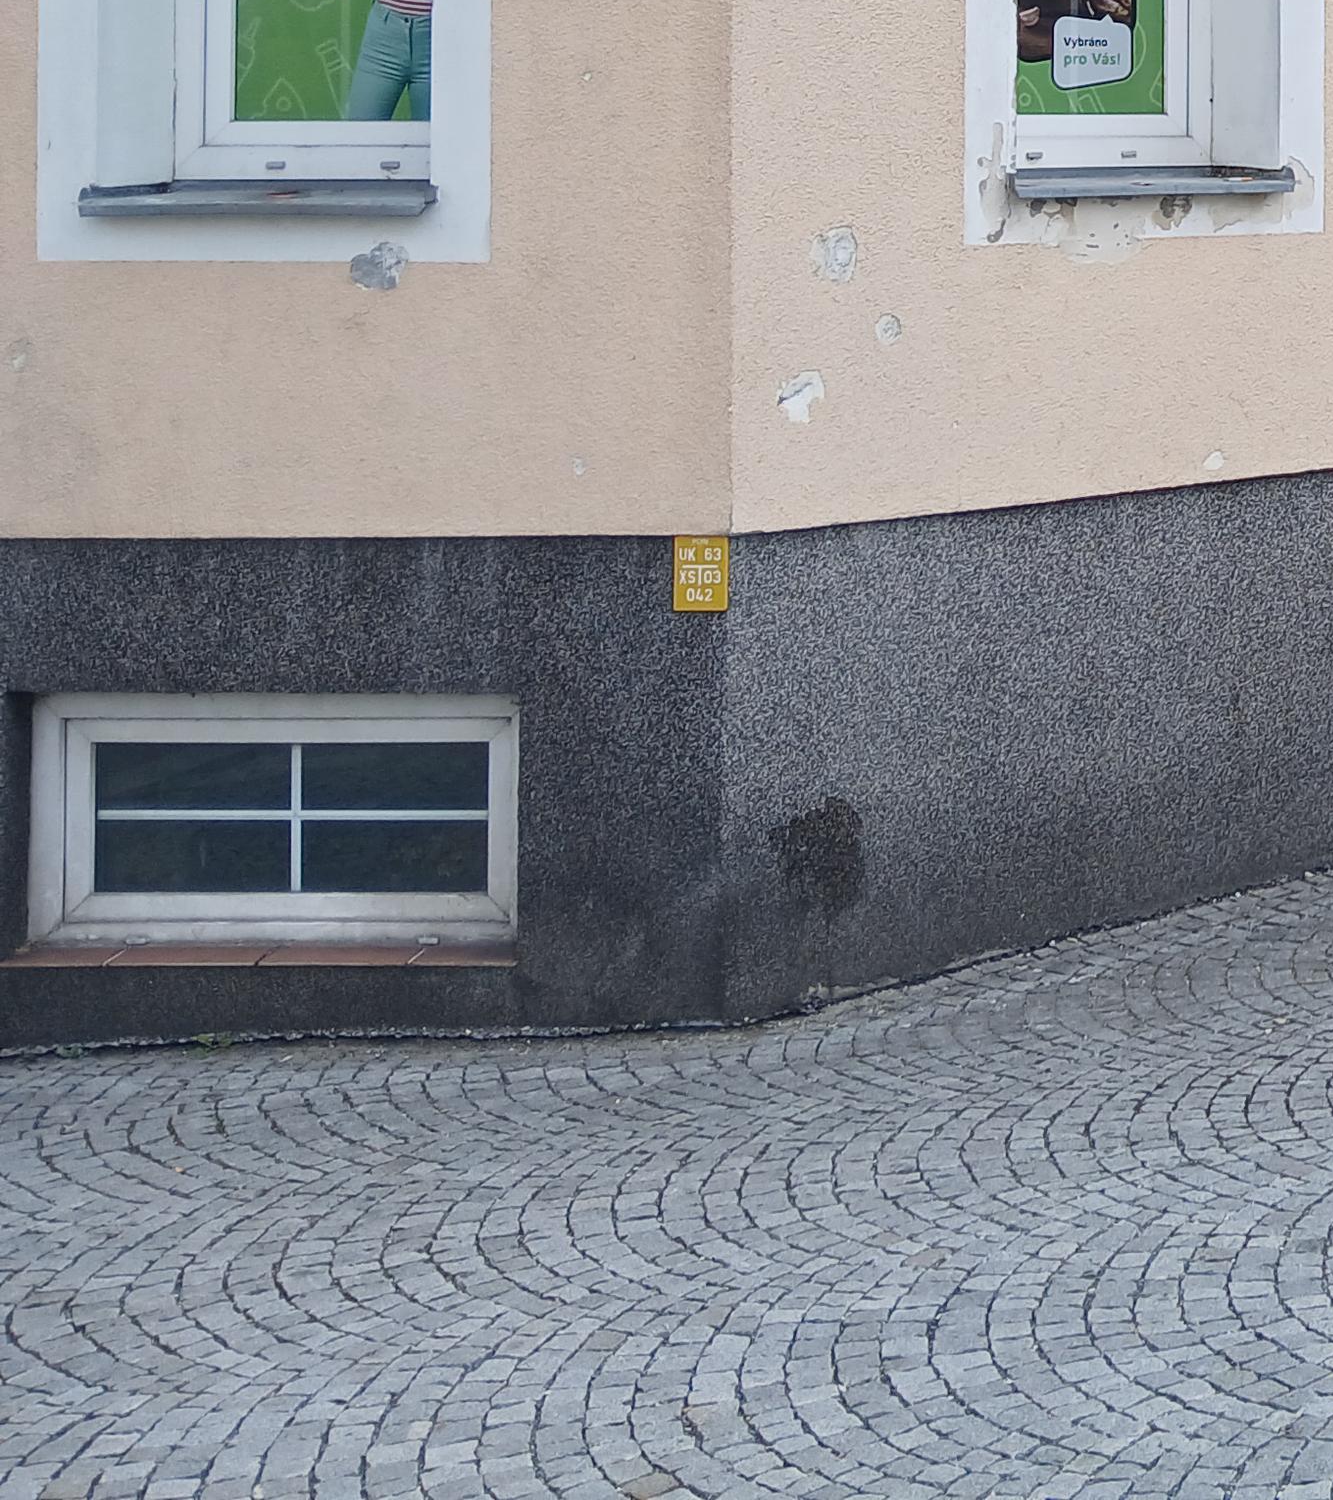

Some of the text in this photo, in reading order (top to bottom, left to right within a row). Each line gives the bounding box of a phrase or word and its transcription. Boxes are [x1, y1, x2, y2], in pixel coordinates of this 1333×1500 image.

[1063, 36, 1109, 49] Vybráno
[1063, 52, 1121, 68] pro Vás!
[679, 547, 722, 562] UK 63
[703, 569, 722, 584] 03
[686, 587, 713, 602] 042
